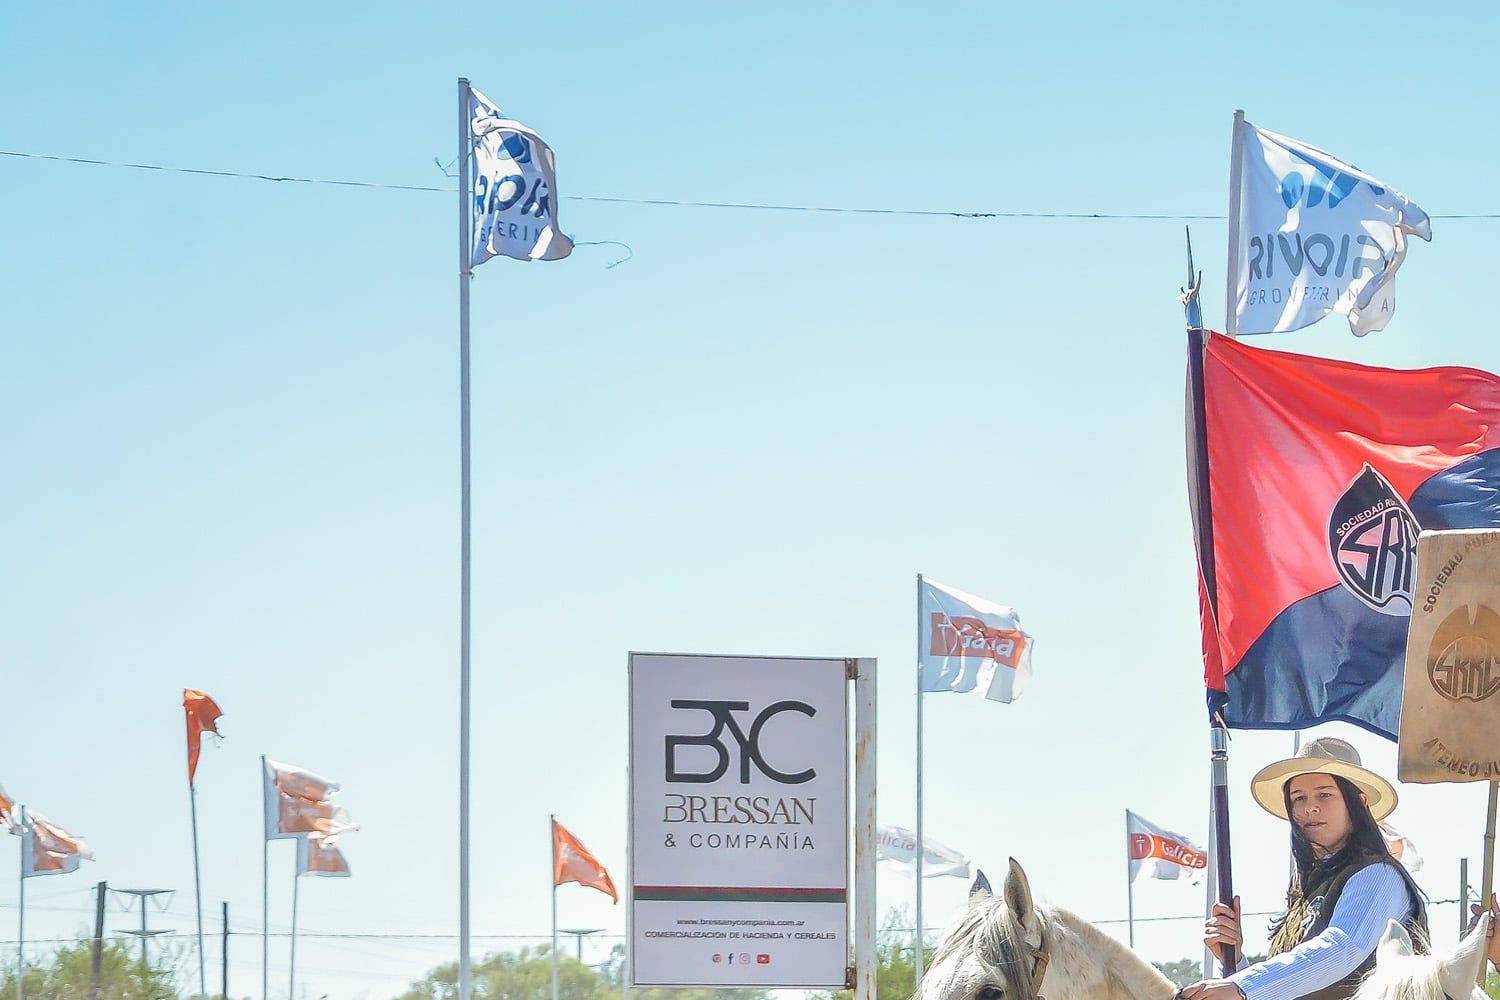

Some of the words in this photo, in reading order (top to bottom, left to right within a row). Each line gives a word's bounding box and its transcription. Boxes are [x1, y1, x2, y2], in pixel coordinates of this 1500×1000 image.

[1336, 499, 1384, 537] SOCIEDAD
[1423, 552, 1463, 614] SOCIEDAD
[1424, 738, 1480, 777] ATENEO
[663, 793, 816, 825] BRESSAN
[664, 832, 676, 847] &
[690, 832, 815, 849] COMPAÑÍA
[729, 931, 740, 939] DE
[742, 931, 784, 939] HACIENDA
[794, 932, 836, 940] CEREALES
